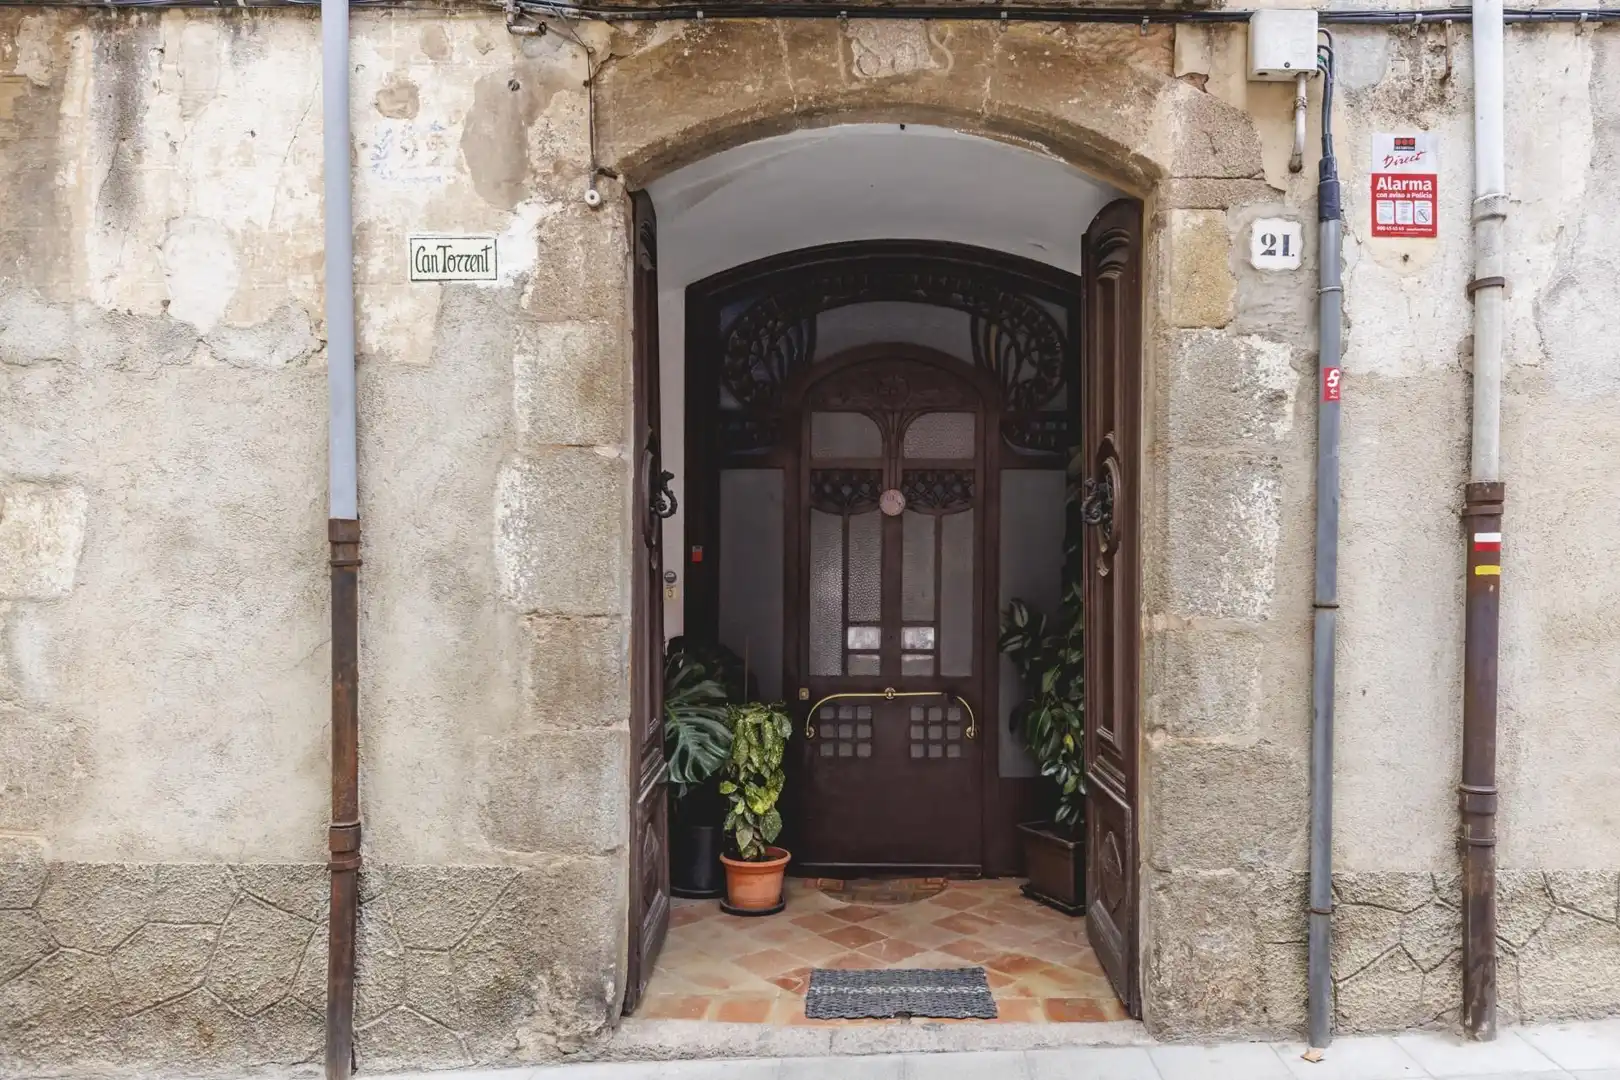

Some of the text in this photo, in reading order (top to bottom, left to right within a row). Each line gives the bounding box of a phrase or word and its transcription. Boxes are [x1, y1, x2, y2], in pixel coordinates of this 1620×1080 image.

[1382, 151, 1426, 168] Direct
[1376, 176, 1432, 190] Alarma
[415, 244, 492, 273] Can Torrent
